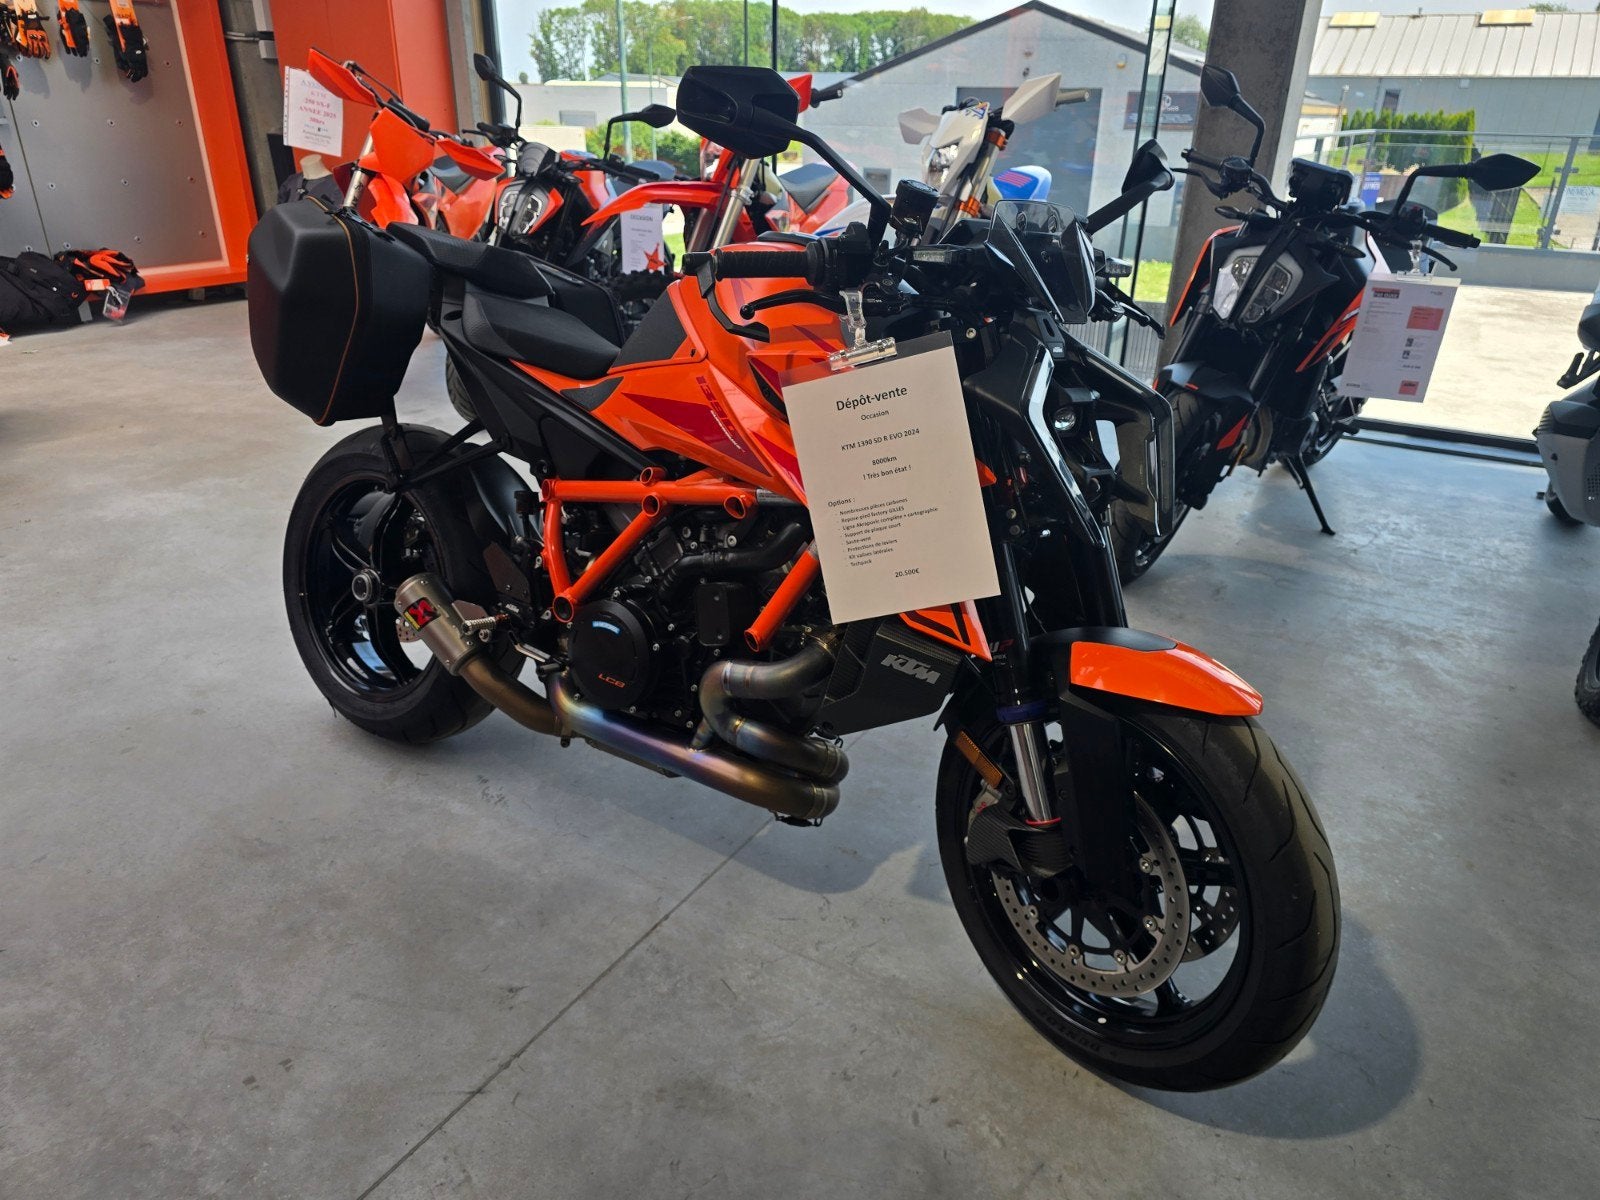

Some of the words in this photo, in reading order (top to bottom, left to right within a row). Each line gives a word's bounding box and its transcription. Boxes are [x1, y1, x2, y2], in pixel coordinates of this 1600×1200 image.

[836, 386, 908, 411] Dépôt-vente
[861, 410, 889, 421] Occasion
[841, 443, 856, 451] KTM
[857, 439, 873, 448] 1390
[889, 432, 903, 440] EVO
[904, 428, 920, 437] 2024
[872, 457, 897, 466] 8000km
[894, 466, 907, 474] état
[828, 498, 852, 507] Options
[895, 568, 920, 578] 20.500€
[880, 653, 941, 685] KTM
[598, 673, 626, 689] LC8
